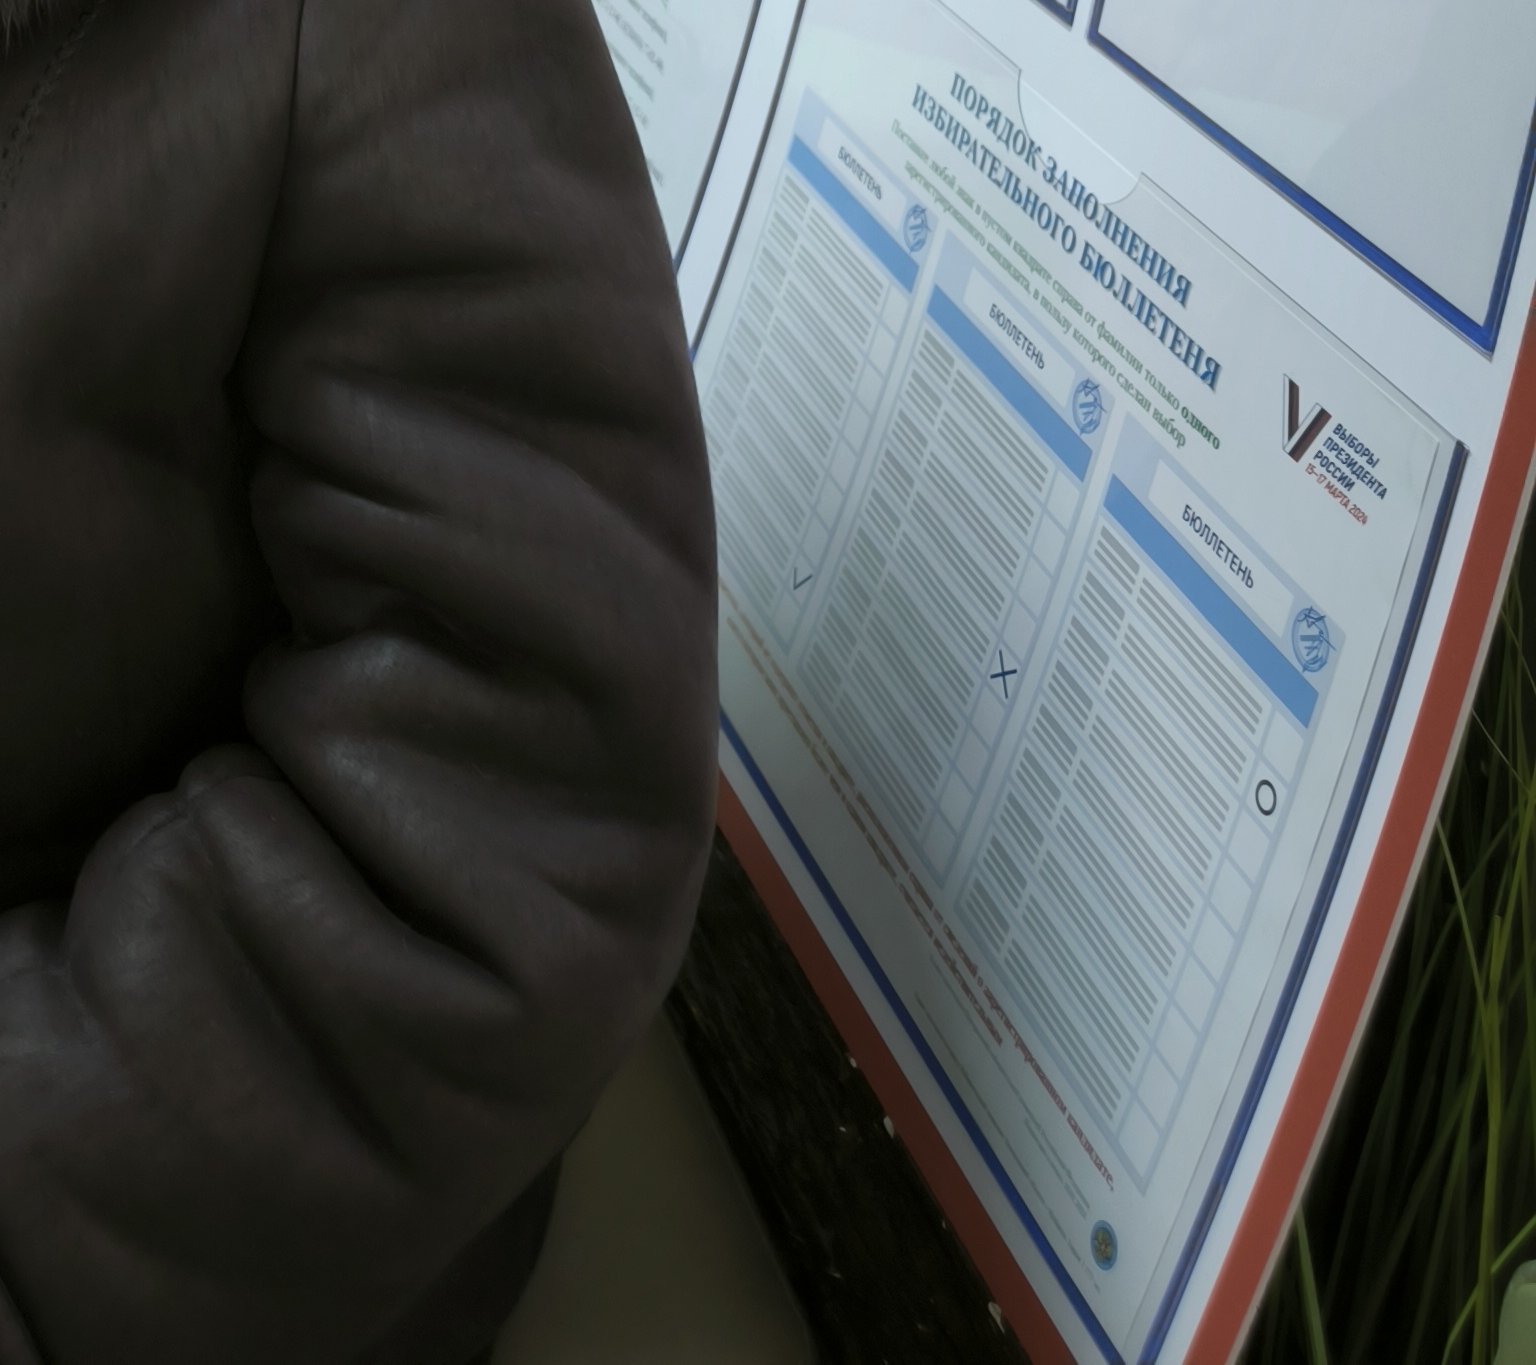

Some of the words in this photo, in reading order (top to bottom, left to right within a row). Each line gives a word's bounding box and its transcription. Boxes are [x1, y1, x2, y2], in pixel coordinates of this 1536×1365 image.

[837, 144, 883, 201] БЮЛЛЕТЕНЬ
[949, 70, 1042, 172] ПОРЯДОК
[1042, 155, 1193, 310] ЗАПОЛНЕНИЯ
[910, 82, 1078, 255] ИЗБИРАТЕЛЬНОГО
[1079, 249, 1223, 393] БЮЛЛЕТЕНЯ
[981, 209, 1013, 248] пустом
[1012, 240, 1053, 285] квадрате
[1052, 278, 1084, 317] справа
[1084, 310, 1097, 329] от
[1096, 321, 1144, 375] фамилии
[1144, 367, 1181, 411] только
[1180, 405, 1221, 451] одного
[988, 302, 1046, 370] БЮЛЛЕТЕНЬ
[1032, 287, 1041, 302] в
[1040, 293, 1073, 335] пользу
[1072, 326, 1117, 378] которого
[1116, 372, 1153, 414] сделан
[1151, 407, 1187, 449] выбор
[1312, 449, 1356, 493] РОССИИ
[1322, 436, 1389, 501] ПРЕЗИДЕНТА
[1332, 422, 1381, 469] ВЫБОРЫ
[1323, 480, 1351, 509] МАРТА
[1348, 503, 1369, 527] 2024
[1181, 503, 1255, 590] БЮЛЛЕТЕНЬ
[1066, 1112, 1114, 1192] кандидате,
